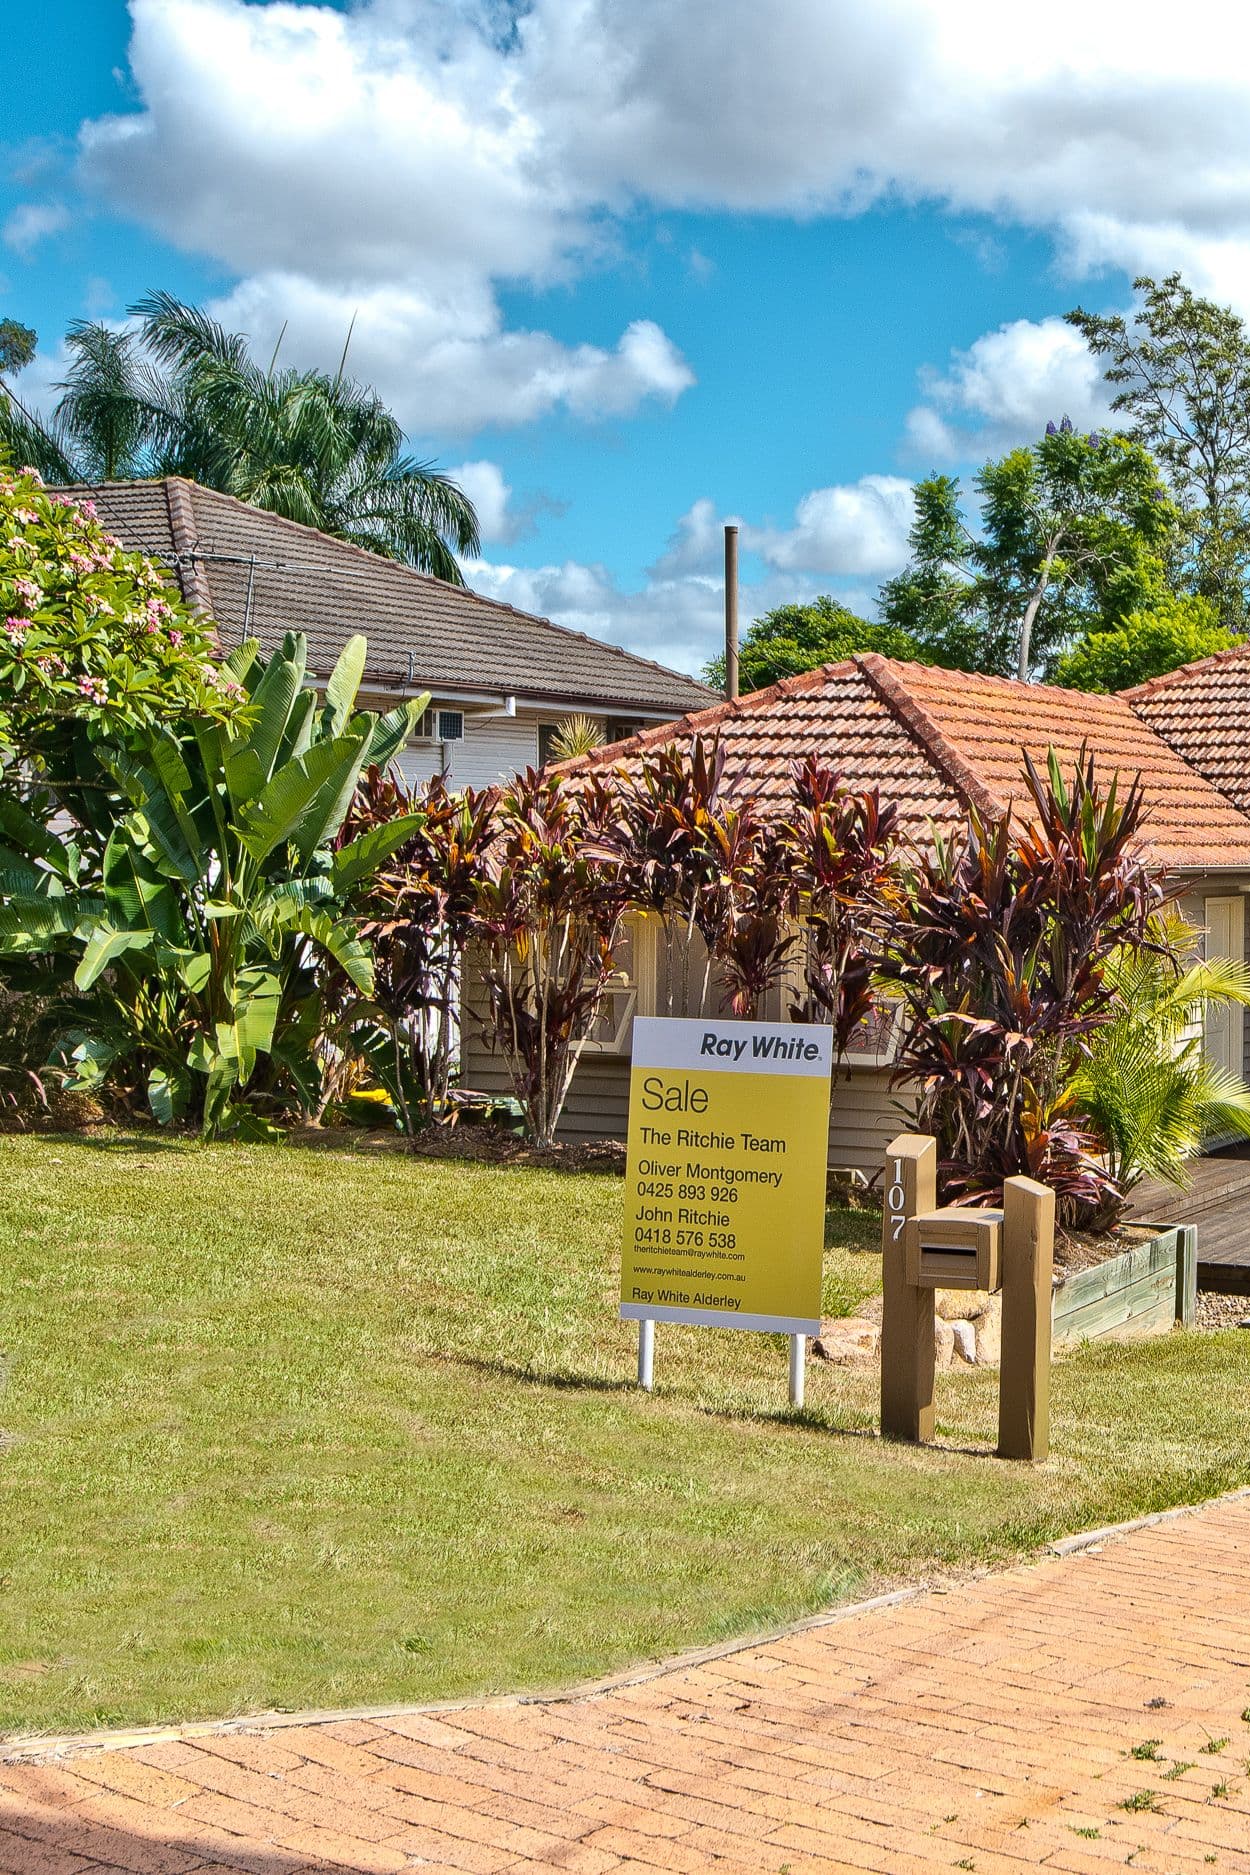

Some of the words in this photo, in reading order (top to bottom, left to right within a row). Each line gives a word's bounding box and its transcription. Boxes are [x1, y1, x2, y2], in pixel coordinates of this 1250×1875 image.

[700, 1033, 748, 1061] Ray
[642, 1077, 709, 1113] Sale
[640, 1127, 671, 1145] The
[677, 1130, 735, 1149] Ritchie
[741, 1133, 786, 1153] Team
[638, 1160, 682, 1177] Oliver
[686, 1163, 783, 1188] Montgomery
[637, 1181, 673, 1198] 0425
[678, 1184, 705, 1201] 893
[711, 1186, 738, 1203] 926
[888, 1158, 906, 1241] 107
[636, 1206, 672, 1222] John
[678, 1208, 730, 1226] Ritchie
[635, 1227, 671, 1244] 0418
[676, 1230, 703, 1246] 576
[709, 1232, 736, 1249] 538
[634, 1245, 745, 1261] theritchieteam@raywhite.com
[633, 1265, 746, 1282] www.raywhitealderley.com.au
[632, 1287, 654, 1301] Ray
[658, 1290, 690, 1303] White
[693, 1293, 741, 1310] Alderley
